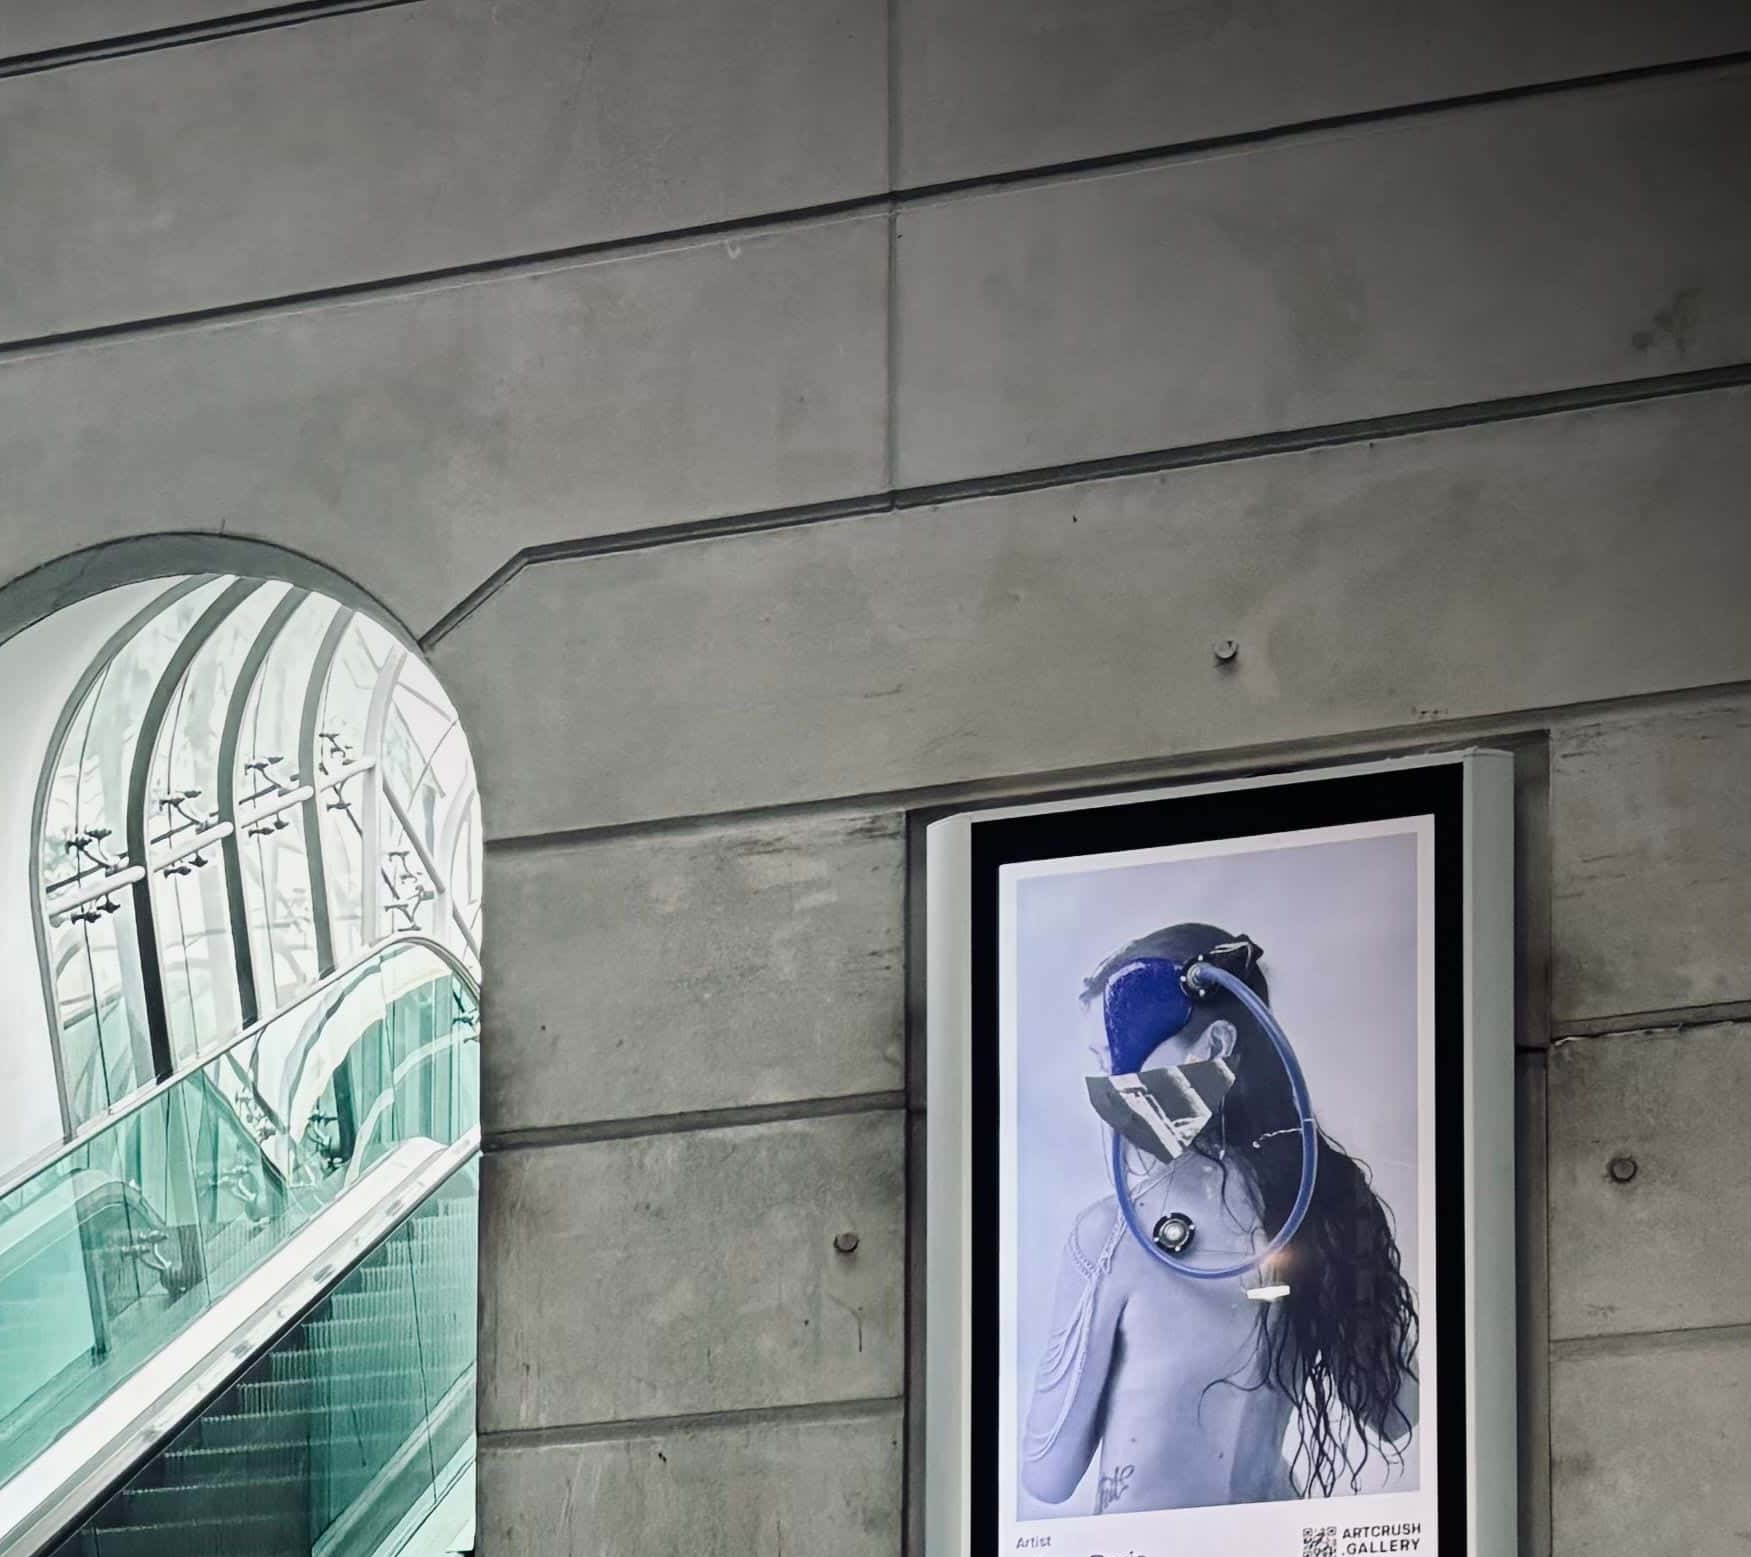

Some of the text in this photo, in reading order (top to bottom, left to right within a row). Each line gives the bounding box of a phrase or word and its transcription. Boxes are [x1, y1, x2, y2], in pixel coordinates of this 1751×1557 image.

[1342, 1522, 1421, 1540] ARTCRUSH
[1016, 1535, 1052, 1549] Artist
[1341, 1538, 1420, 1557] .GALLERY
